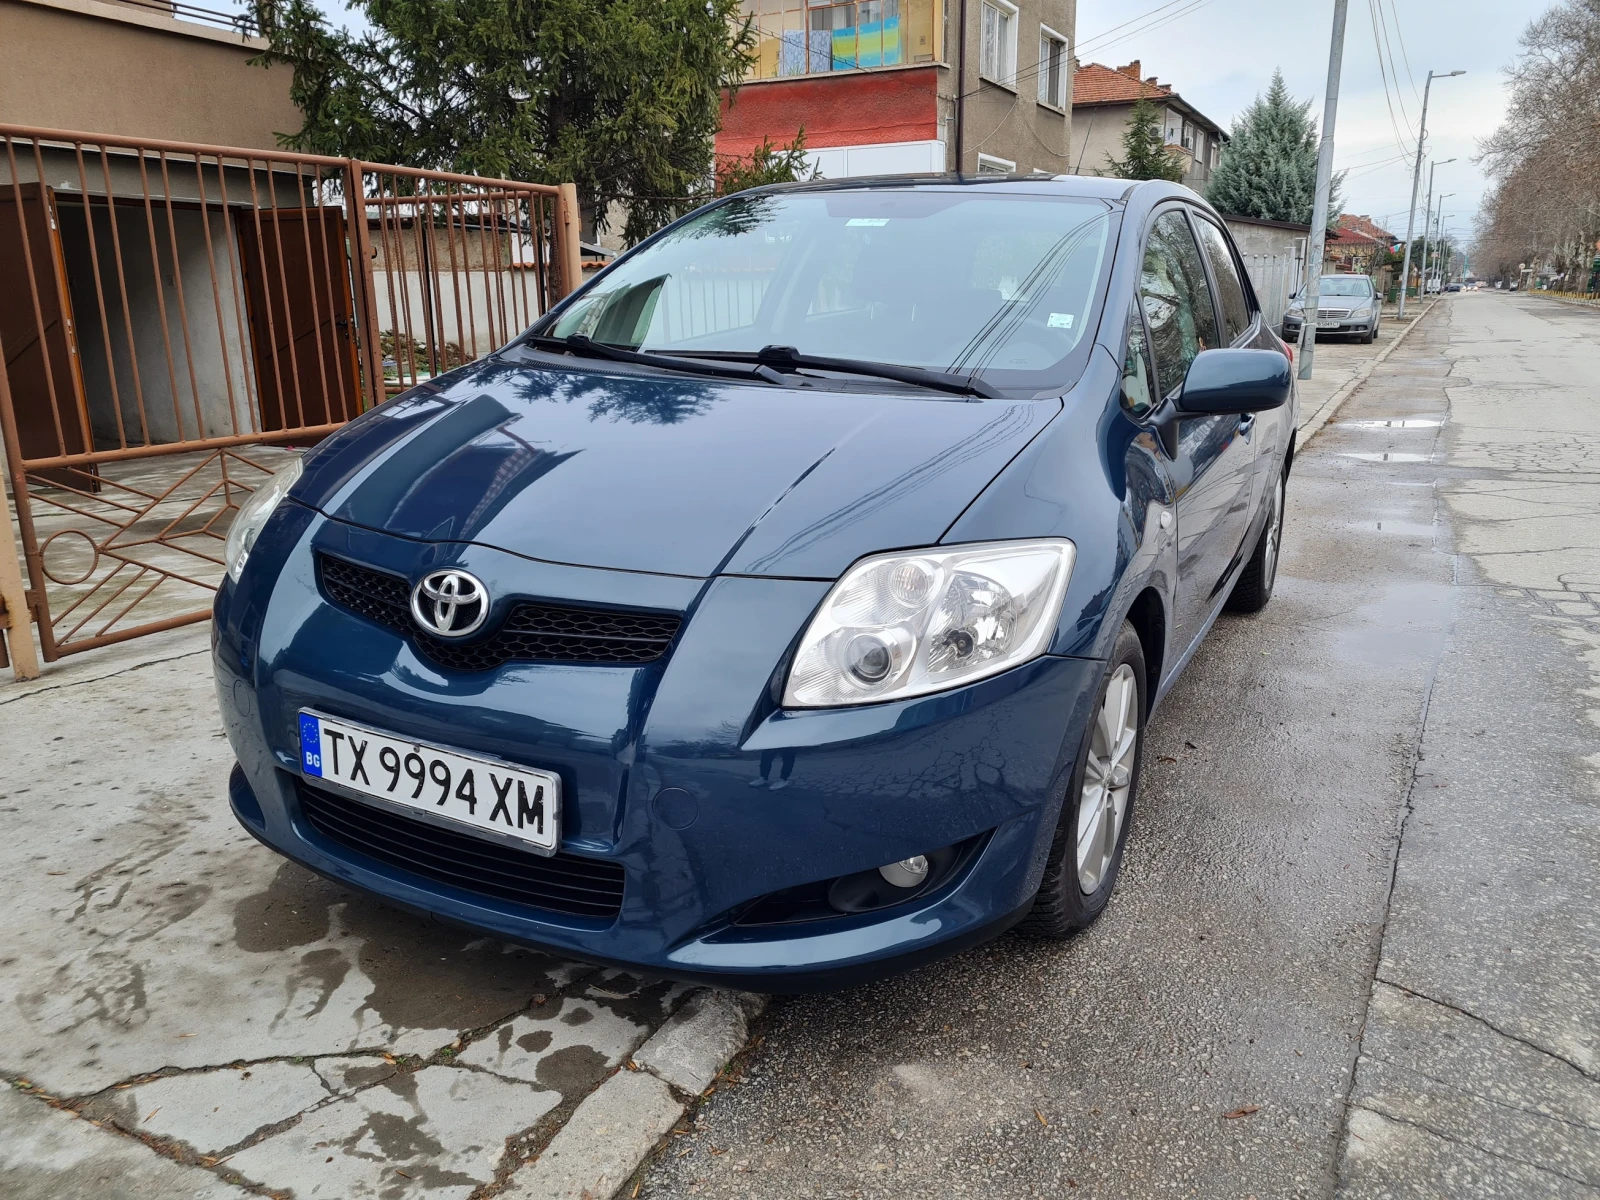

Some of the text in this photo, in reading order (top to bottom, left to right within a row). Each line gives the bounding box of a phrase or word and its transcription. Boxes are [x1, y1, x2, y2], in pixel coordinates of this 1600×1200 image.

[305, 751, 320, 768] BG
[323, 728, 544, 835] TX 9994 XM
